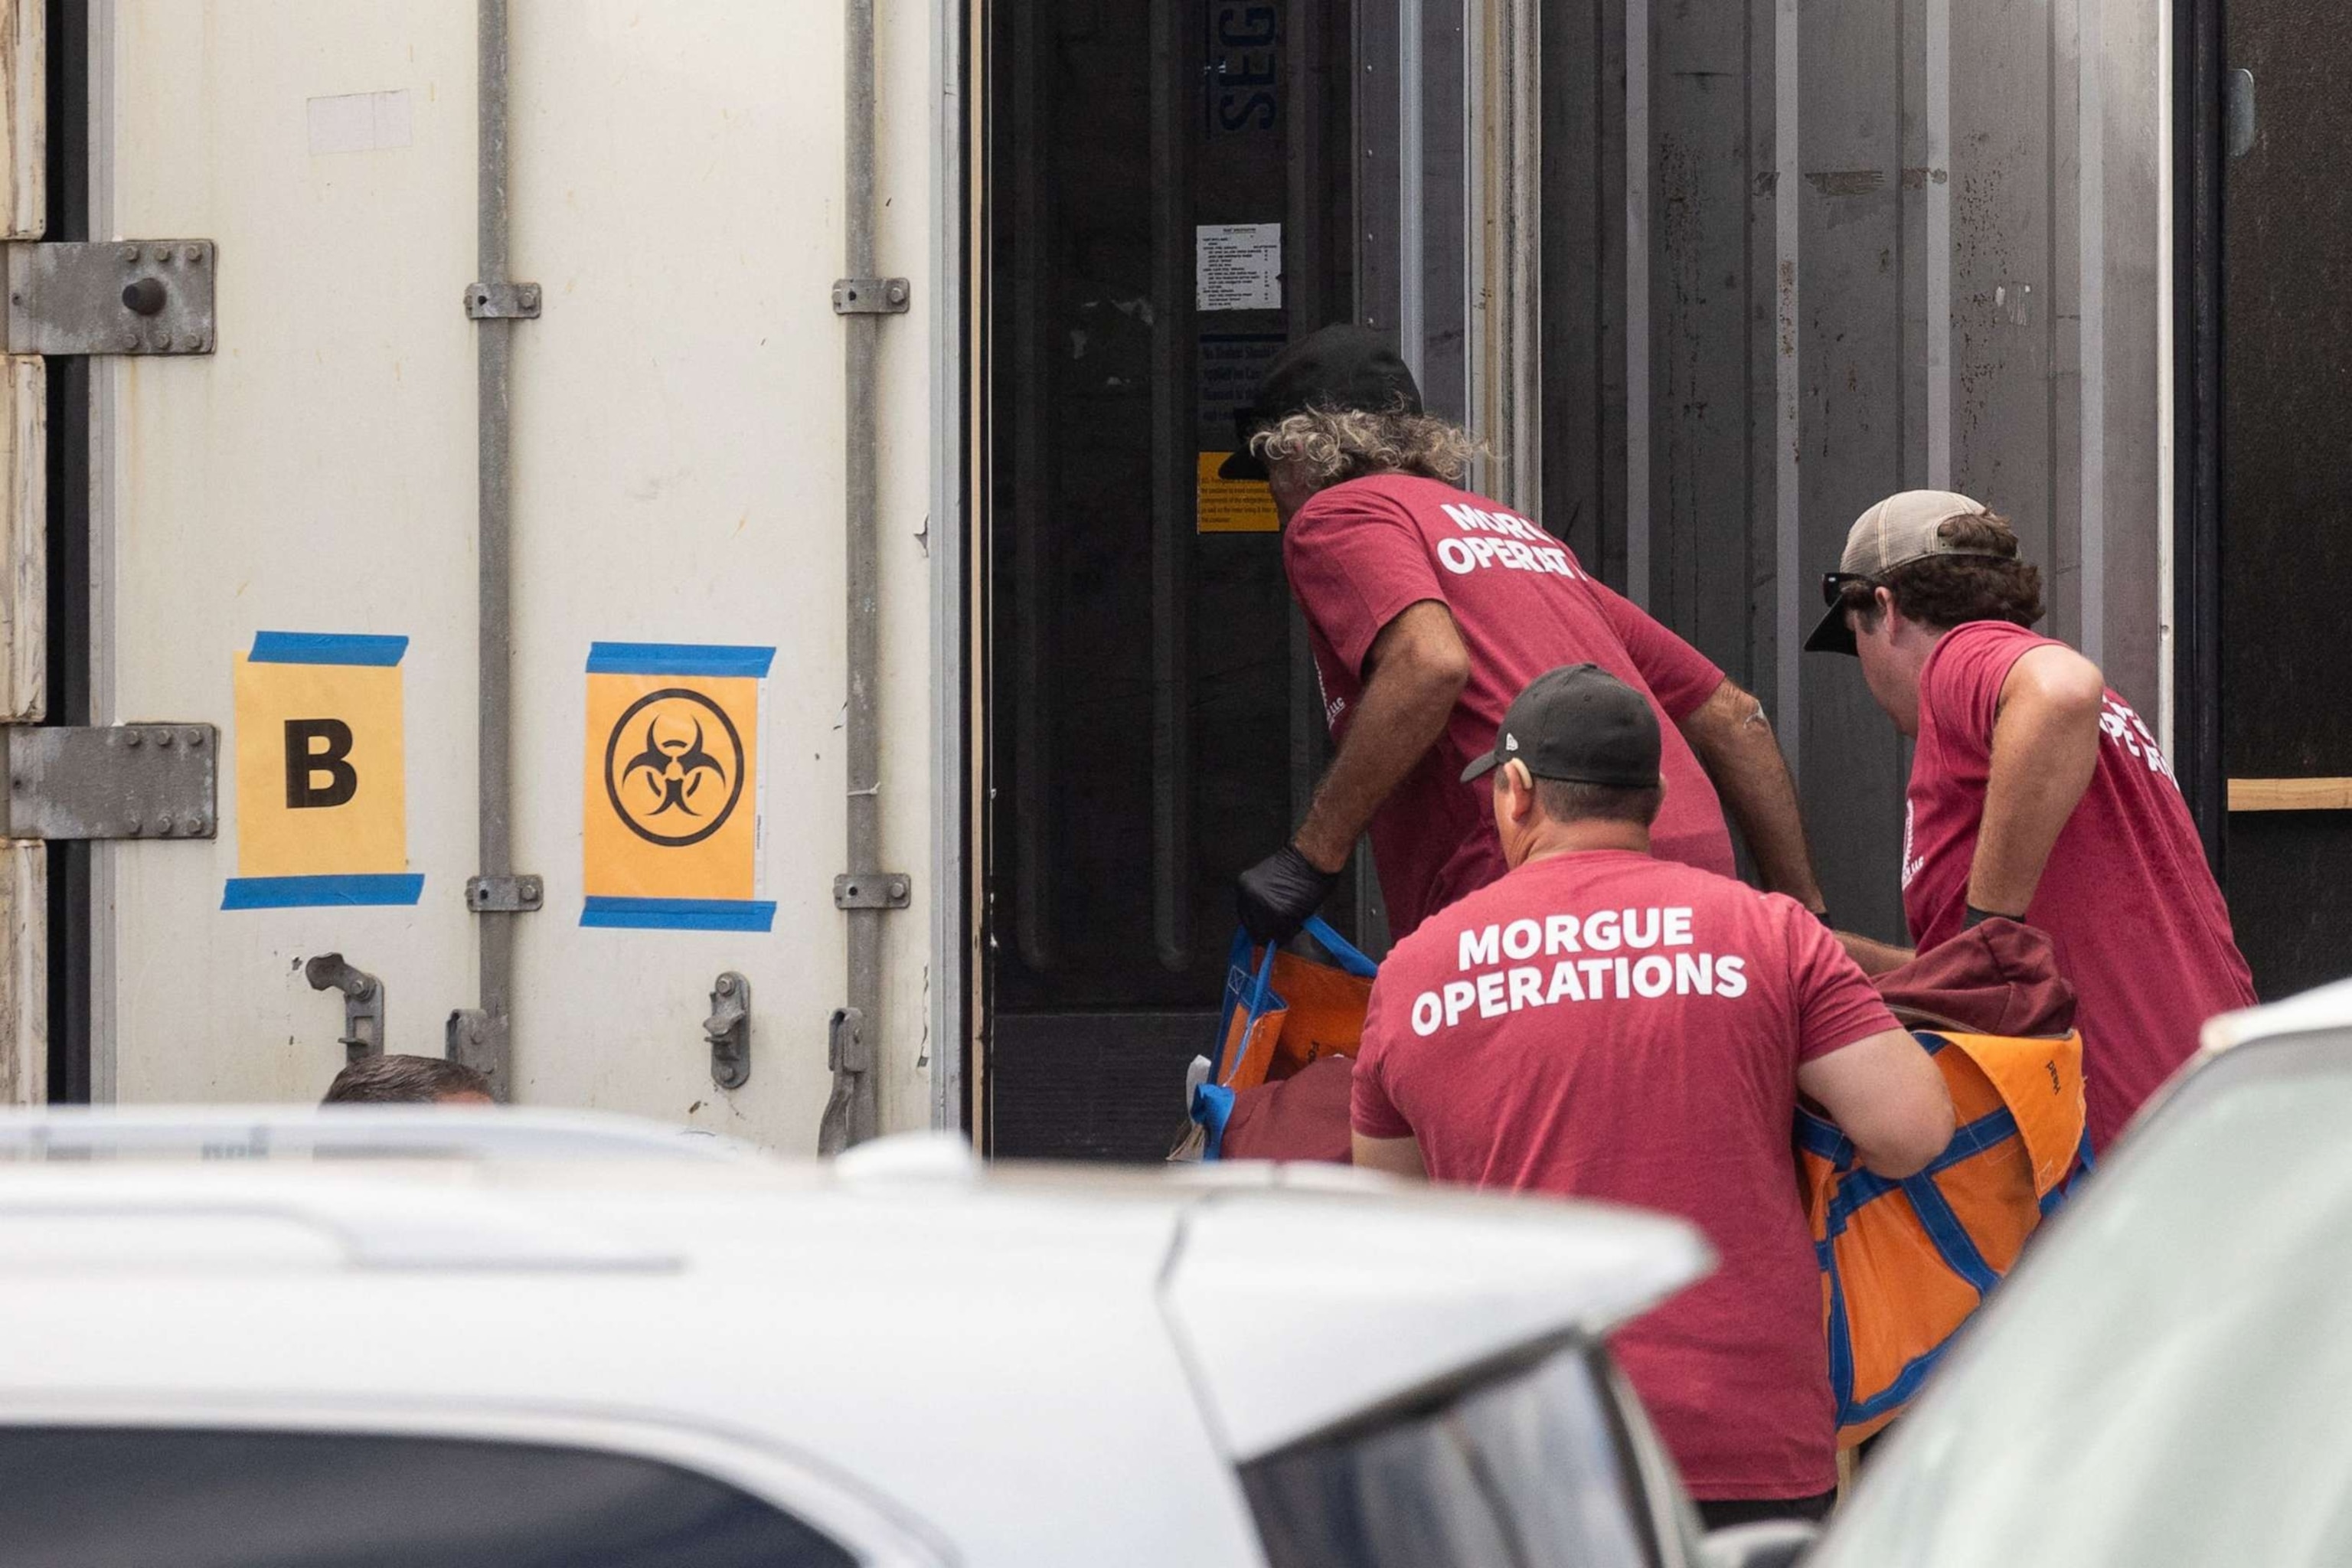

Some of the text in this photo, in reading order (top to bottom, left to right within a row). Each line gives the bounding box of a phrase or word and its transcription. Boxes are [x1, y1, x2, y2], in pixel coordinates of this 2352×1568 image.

[1219, 0, 1276, 130] SEG
[1437, 537, 1588, 582] OPERAT
[283, 717, 358, 808] B
[1459, 907, 1694, 971] MORGUE
[1411, 952, 1748, 1037] OPERATIONS
